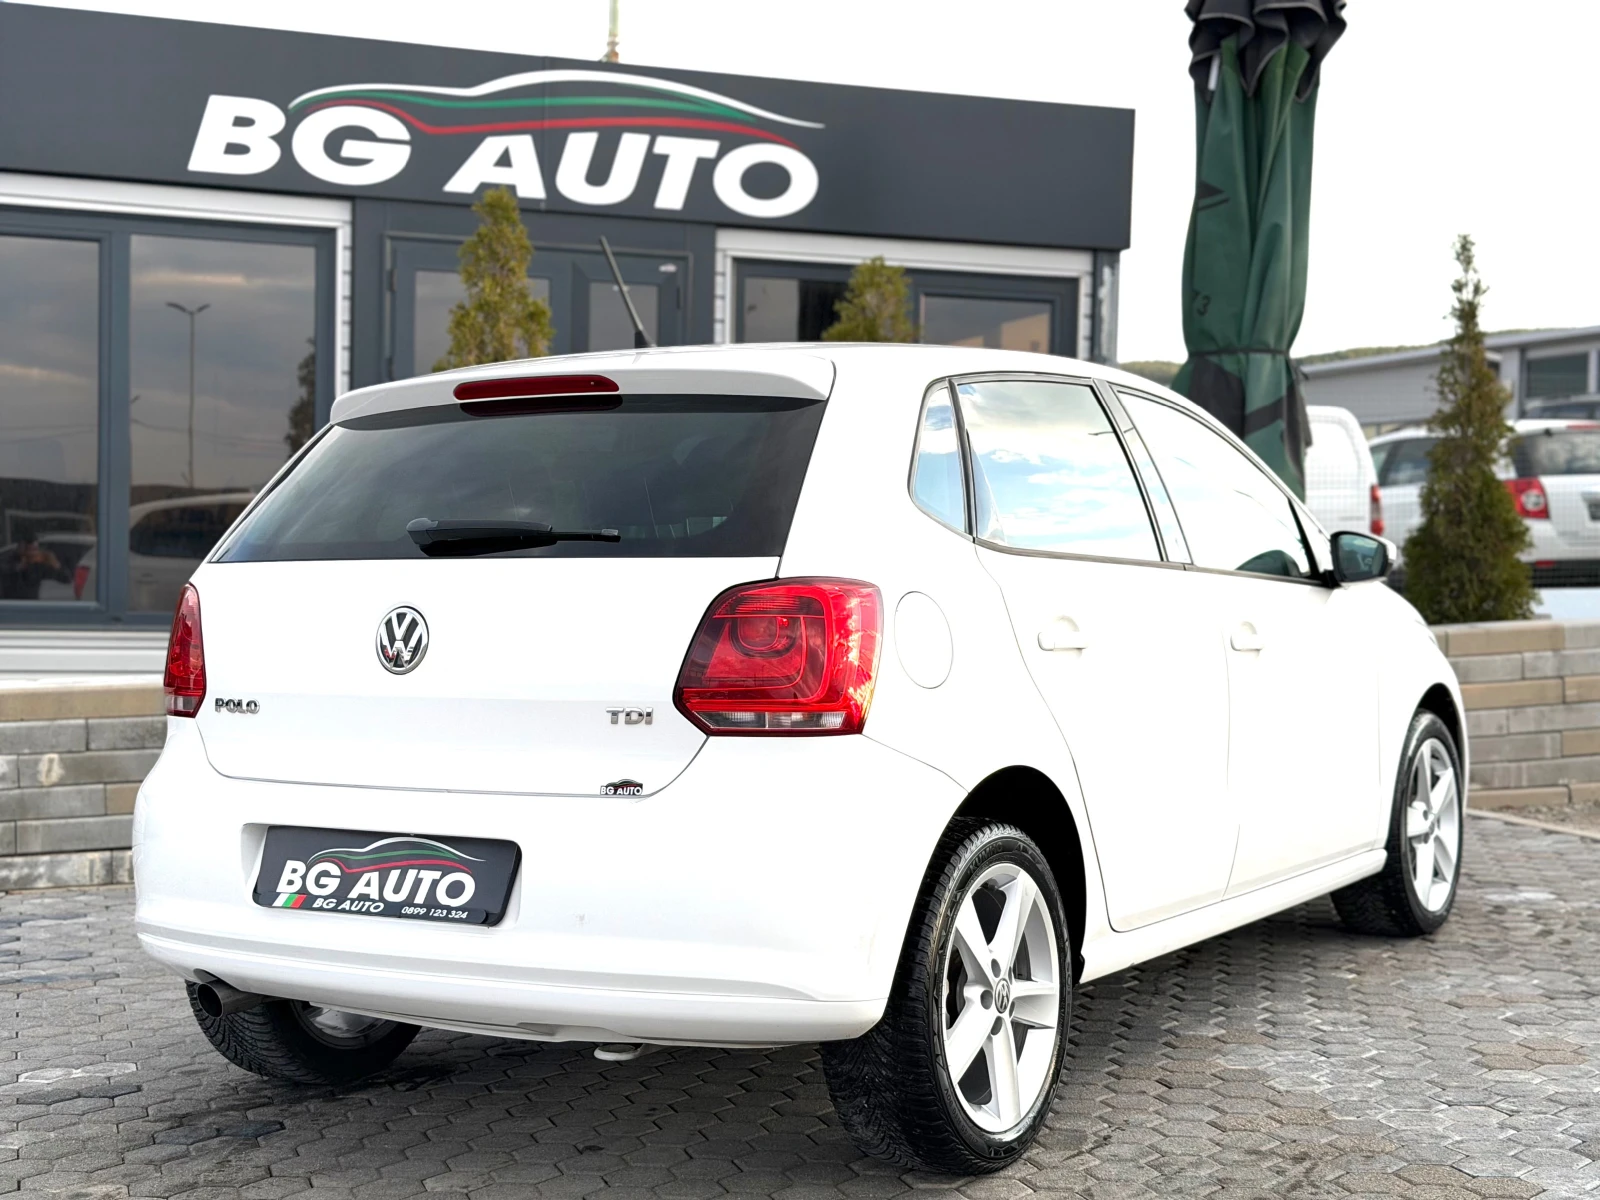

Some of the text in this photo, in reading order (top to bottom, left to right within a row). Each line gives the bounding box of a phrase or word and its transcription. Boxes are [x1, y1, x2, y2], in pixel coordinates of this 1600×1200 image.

[187, 94, 819, 217] BG AUTO
[215, 698, 260, 714] POLO
[605, 706, 653, 725] TDI
[600, 786, 642, 796] BG AUTO
[276, 860, 475, 907] BG AUTO
[312, 898, 384, 914] BG AUTO
[401, 906, 468, 919] 0899 123 324
